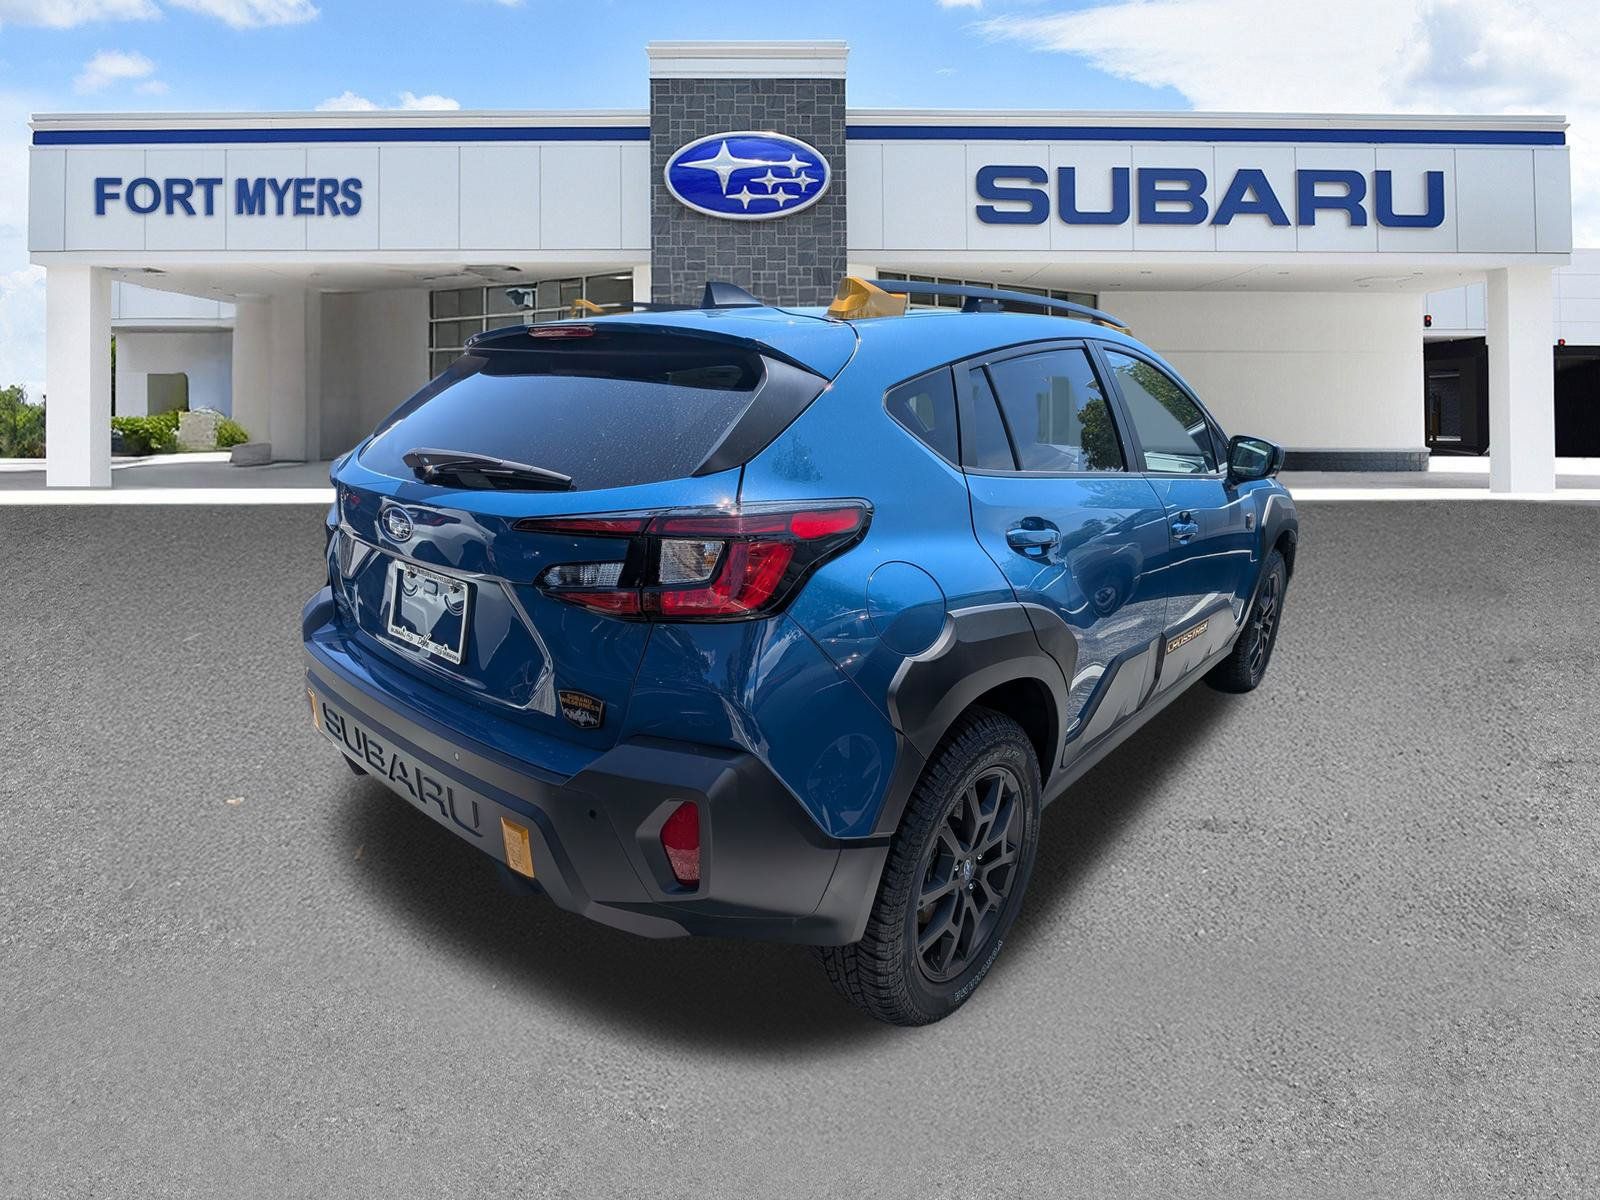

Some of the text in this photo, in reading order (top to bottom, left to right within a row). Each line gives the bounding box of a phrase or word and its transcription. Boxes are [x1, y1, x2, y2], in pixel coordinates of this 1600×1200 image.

[94, 177, 363, 217] FORT MYERS
[975, 165, 1445, 228] SUBARU
[322, 702, 483, 838] SUBARU
